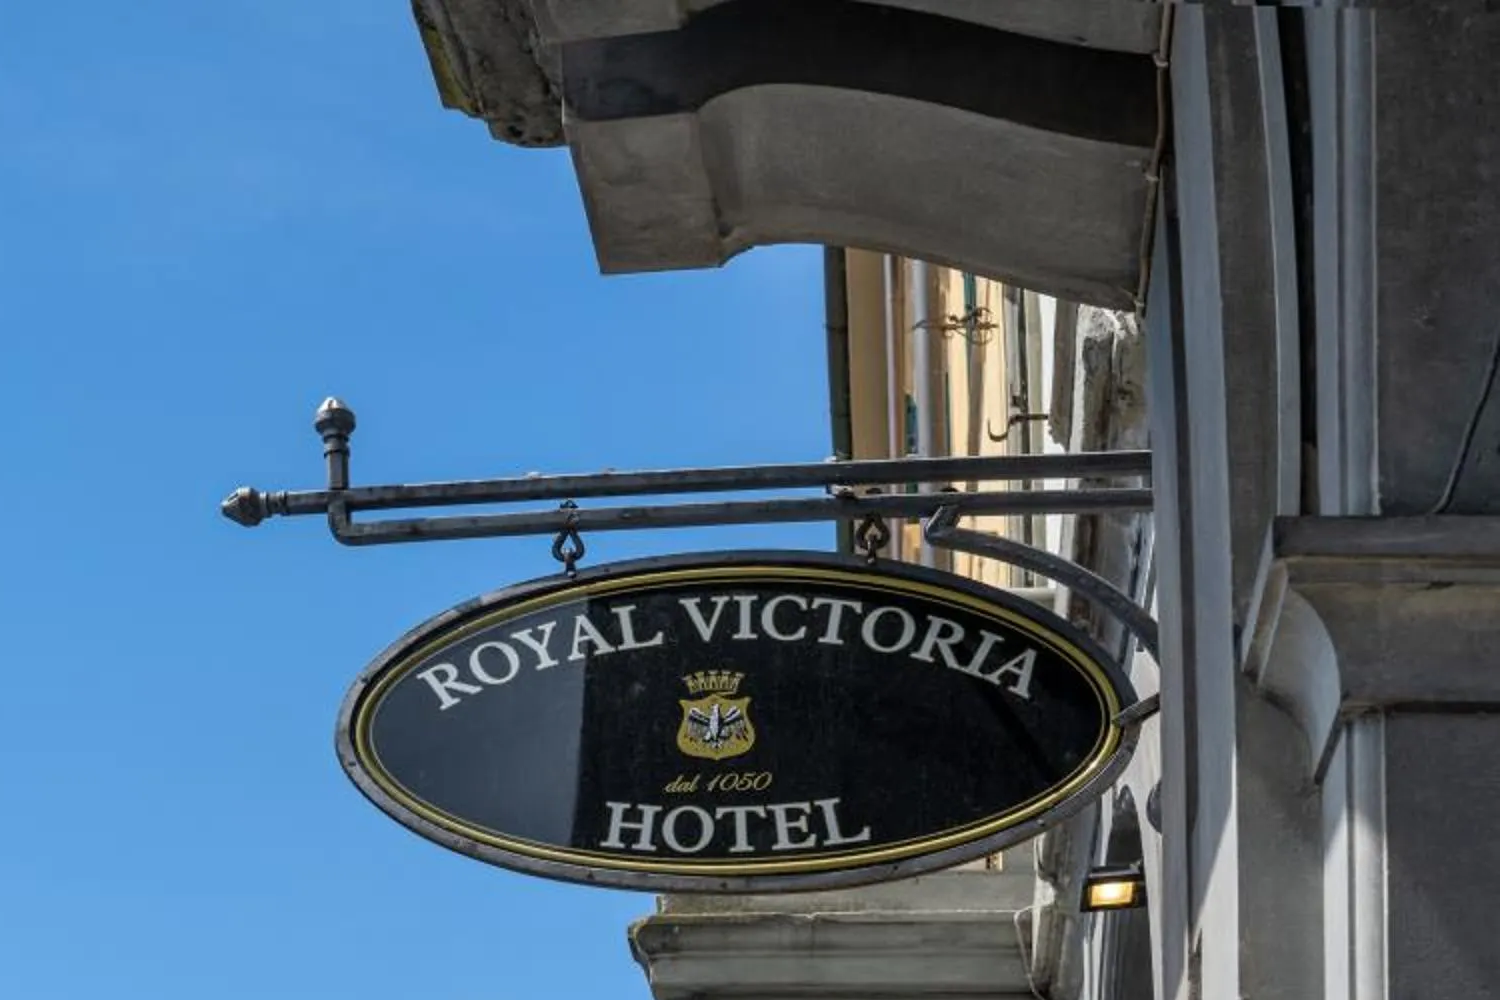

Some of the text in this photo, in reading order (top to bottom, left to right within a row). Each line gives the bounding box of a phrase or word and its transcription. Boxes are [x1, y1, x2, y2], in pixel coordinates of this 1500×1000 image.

[416, 594, 1039, 711] ROYAL VICTORIA
[664, 771, 773, 793] dal 1050
[601, 797, 872, 853] HOTEL
